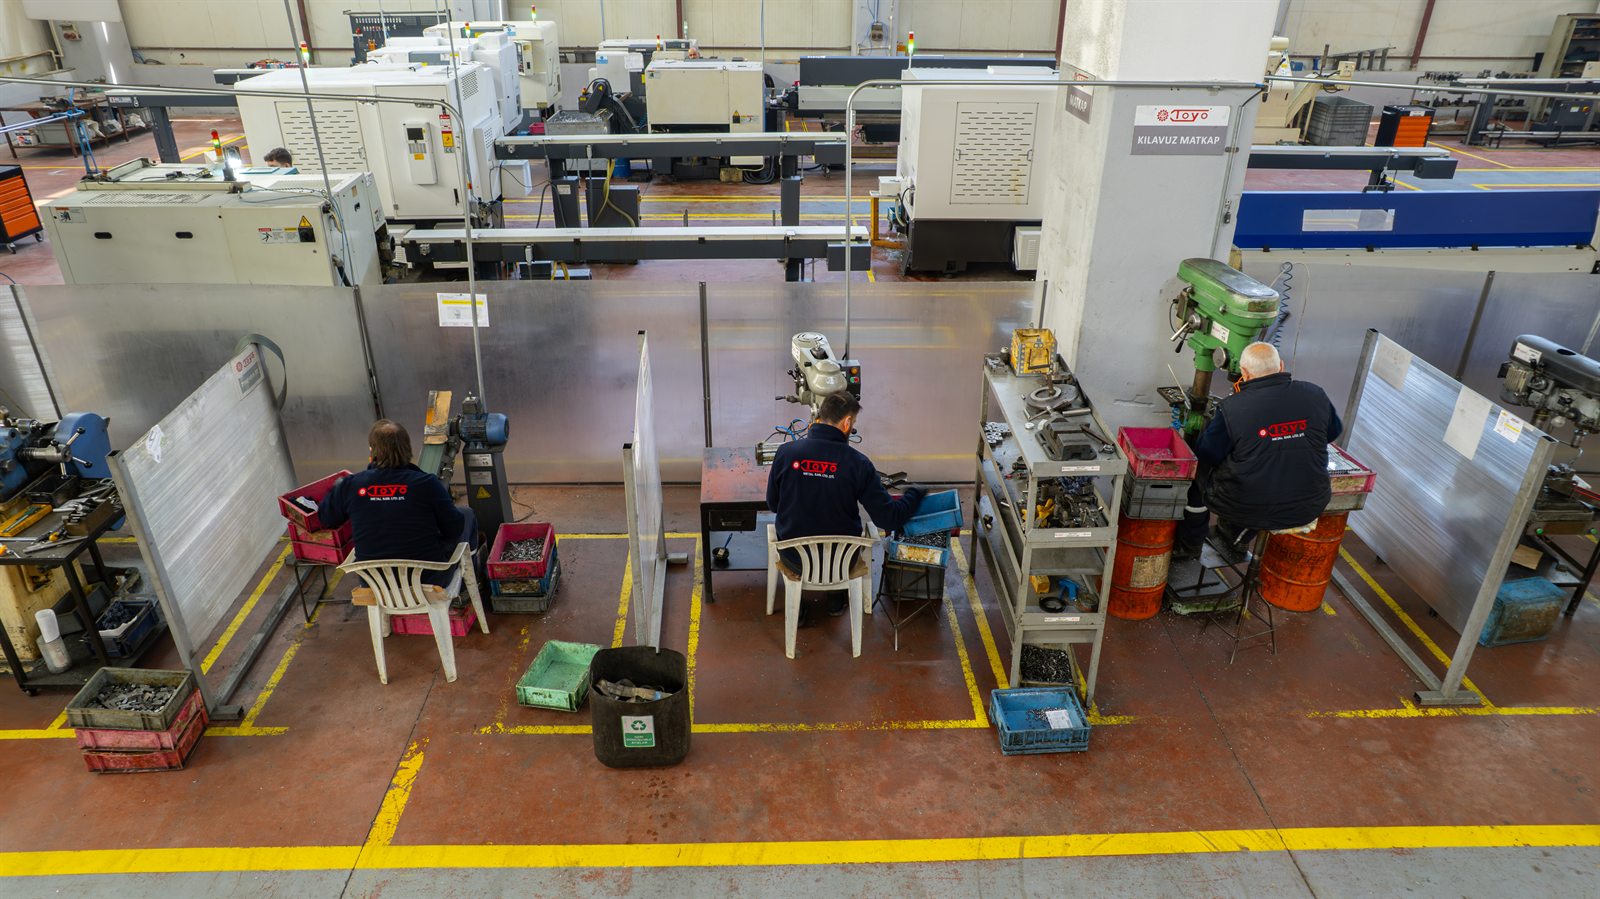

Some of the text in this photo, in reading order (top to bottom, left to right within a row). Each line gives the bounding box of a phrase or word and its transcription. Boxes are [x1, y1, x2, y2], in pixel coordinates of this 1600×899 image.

[1070, 94, 1088, 112] MATKAP
[1170, 109, 1209, 122] Toyo
[1137, 136, 1220, 144] KILAVUZ MATKAP
[801, 459, 838, 473] Toyo
[367, 484, 408, 497] Toyo
